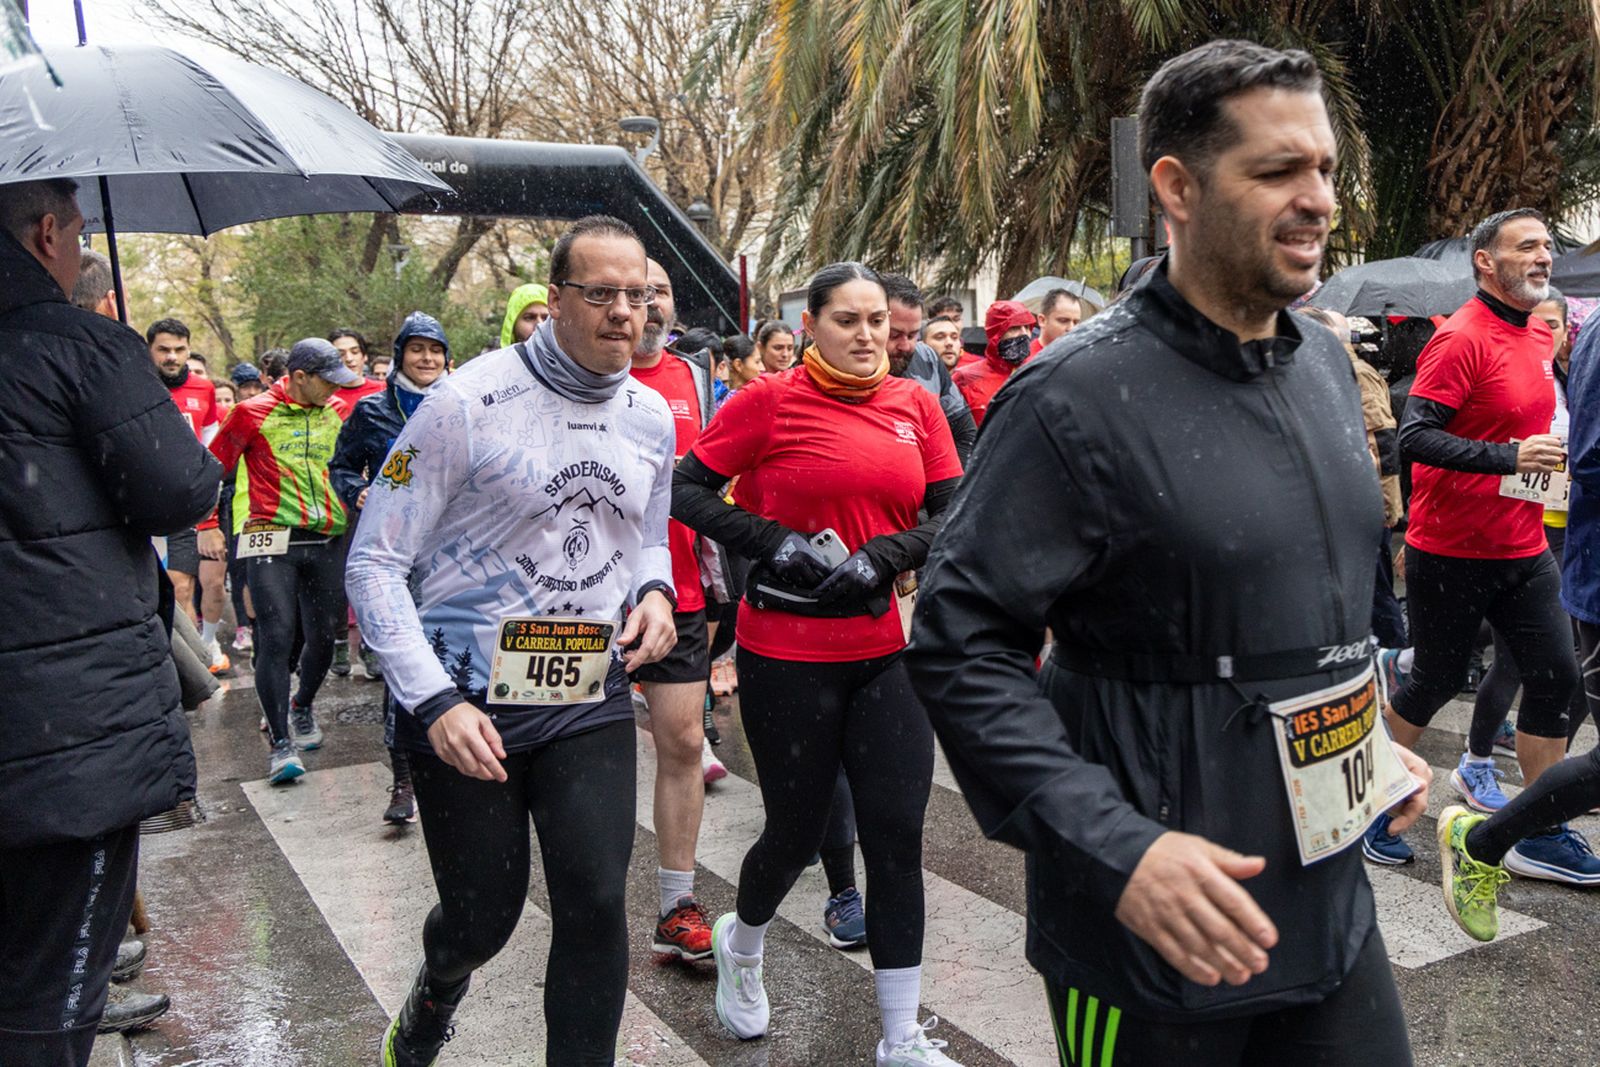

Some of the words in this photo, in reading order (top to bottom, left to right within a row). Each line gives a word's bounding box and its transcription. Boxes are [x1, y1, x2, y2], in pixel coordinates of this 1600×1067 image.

[449, 161, 469, 174] de
[567, 421, 597, 431] luanvi
[545, 461, 626, 497] SENDERISMO
[249, 533, 273, 548] 835
[611, 550, 624, 566] FS
[530, 623, 549, 635] San
[551, 624, 575, 636] Juan
[577, 624, 600, 635] Bosc
[506, 636, 514, 649] V
[515, 637, 562, 650] CARRERA
[565, 637, 605, 650] POPULAR
[526, 655, 582, 687] 465
[1293, 713, 1319, 735] IES
[1321, 704, 1348, 726] San
[1293, 740, 1306, 762] V
[1310, 719, 1365, 757] CARRERA
[74, 946, 89, 973] FILA
